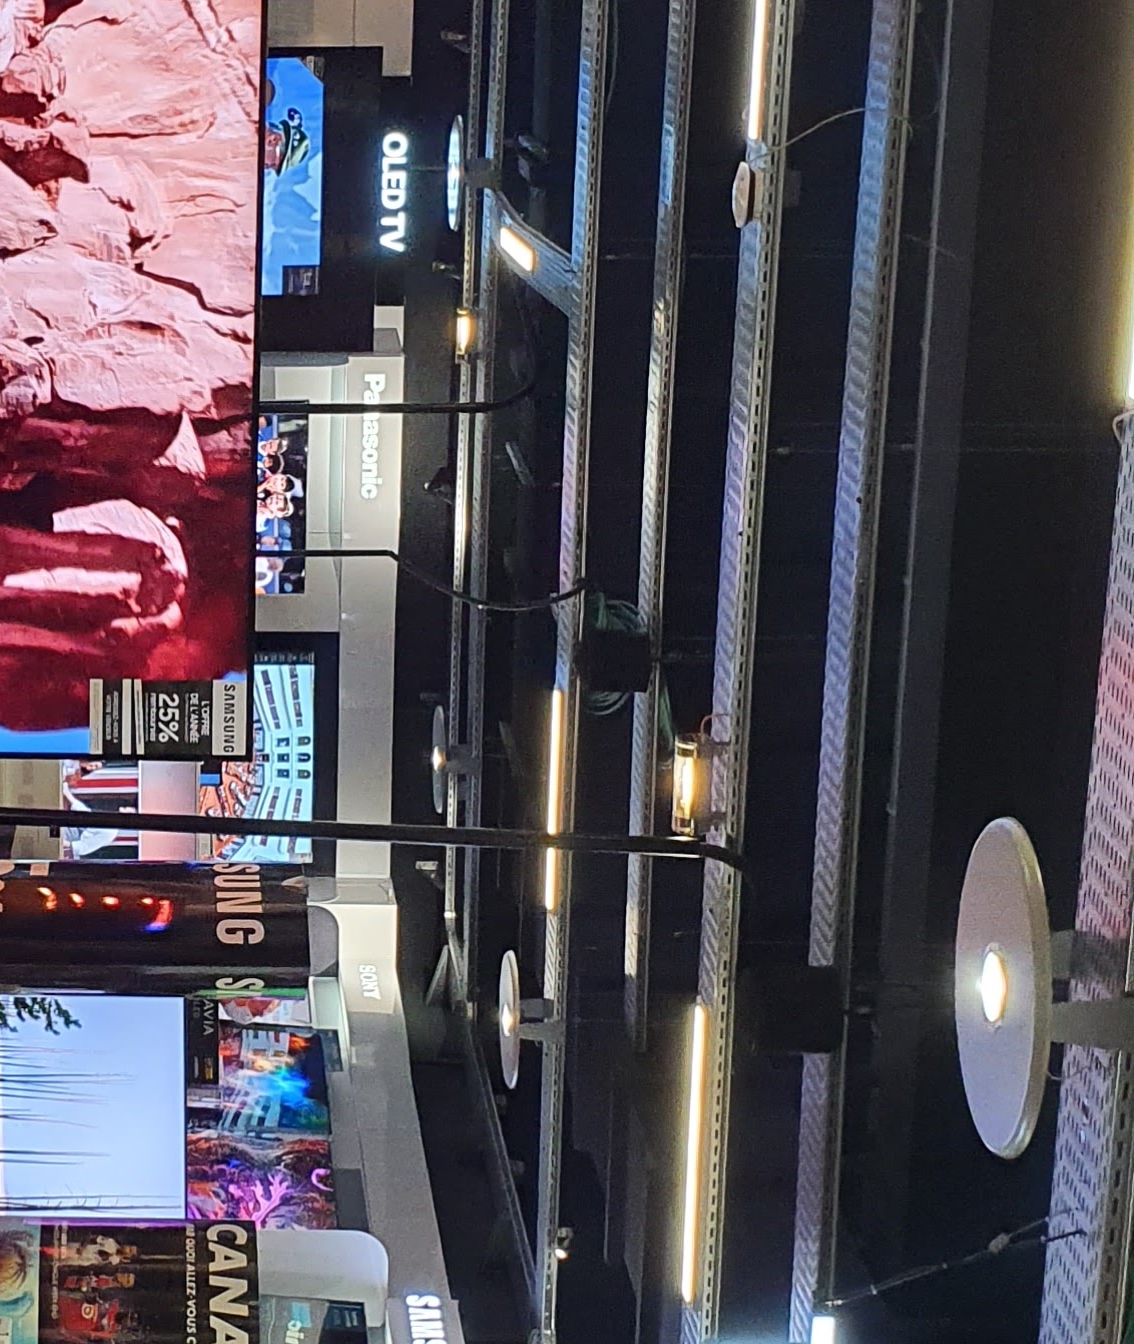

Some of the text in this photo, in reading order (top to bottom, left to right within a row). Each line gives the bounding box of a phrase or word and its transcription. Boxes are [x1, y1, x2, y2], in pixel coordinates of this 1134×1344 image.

[379, 131, 409, 253] OLED TV
[157, 692, 180, 743] 25%
[189, 692, 201, 744] DE L'ANNÉE
[201, 701, 210, 736] L'OFFRE
[222, 684, 236, 754] SAMSUNG
[359, 964, 381, 999] SONY
[186, 1263, 197, 1334] ALLEZ-VOUS
